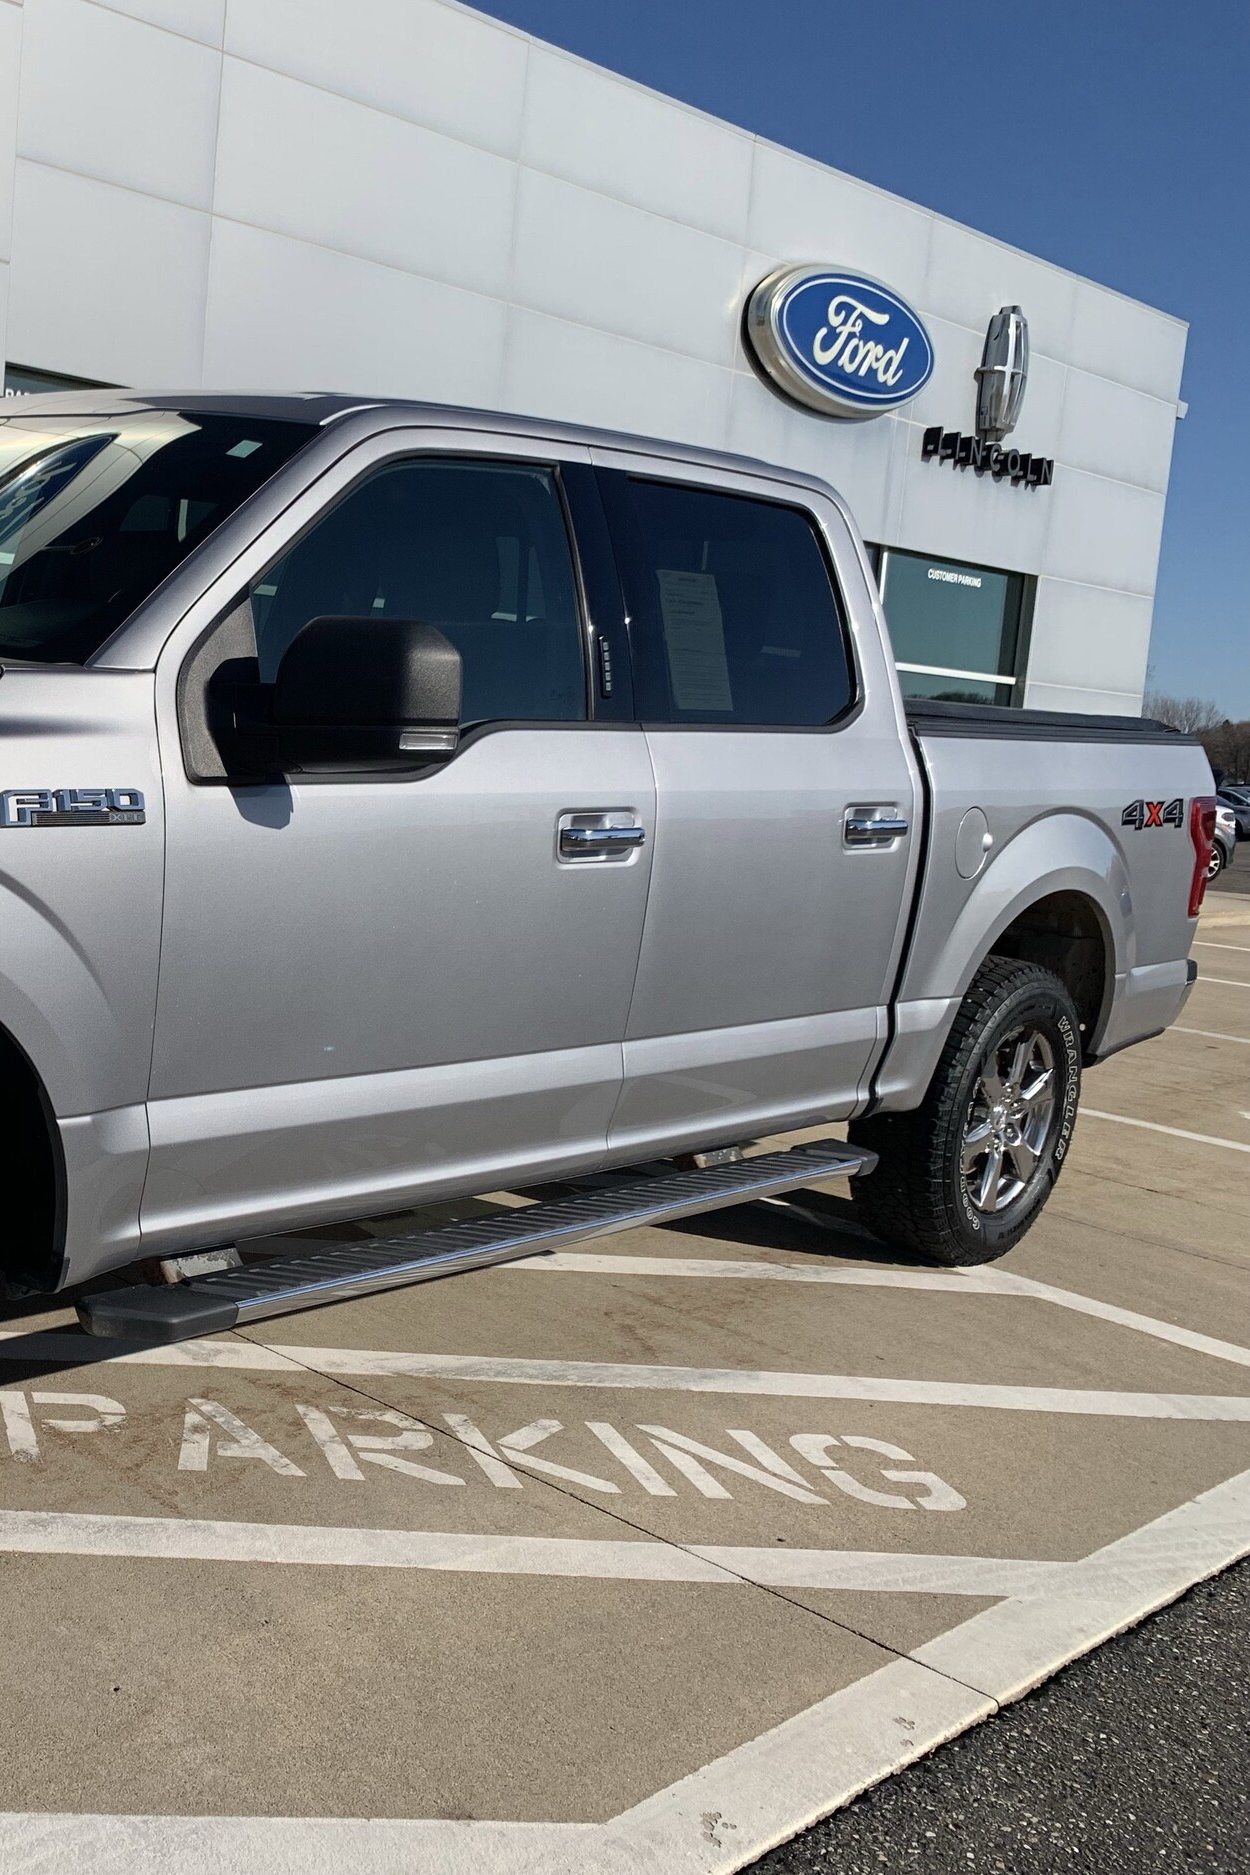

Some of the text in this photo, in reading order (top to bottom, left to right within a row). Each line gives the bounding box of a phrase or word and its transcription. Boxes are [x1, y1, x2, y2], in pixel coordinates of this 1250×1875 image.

[813, 295, 909, 387] Ford
[928, 568, 981, 588] CUSTOMER PARKING
[1056, 1015, 1080, 1161] WRANGLER
